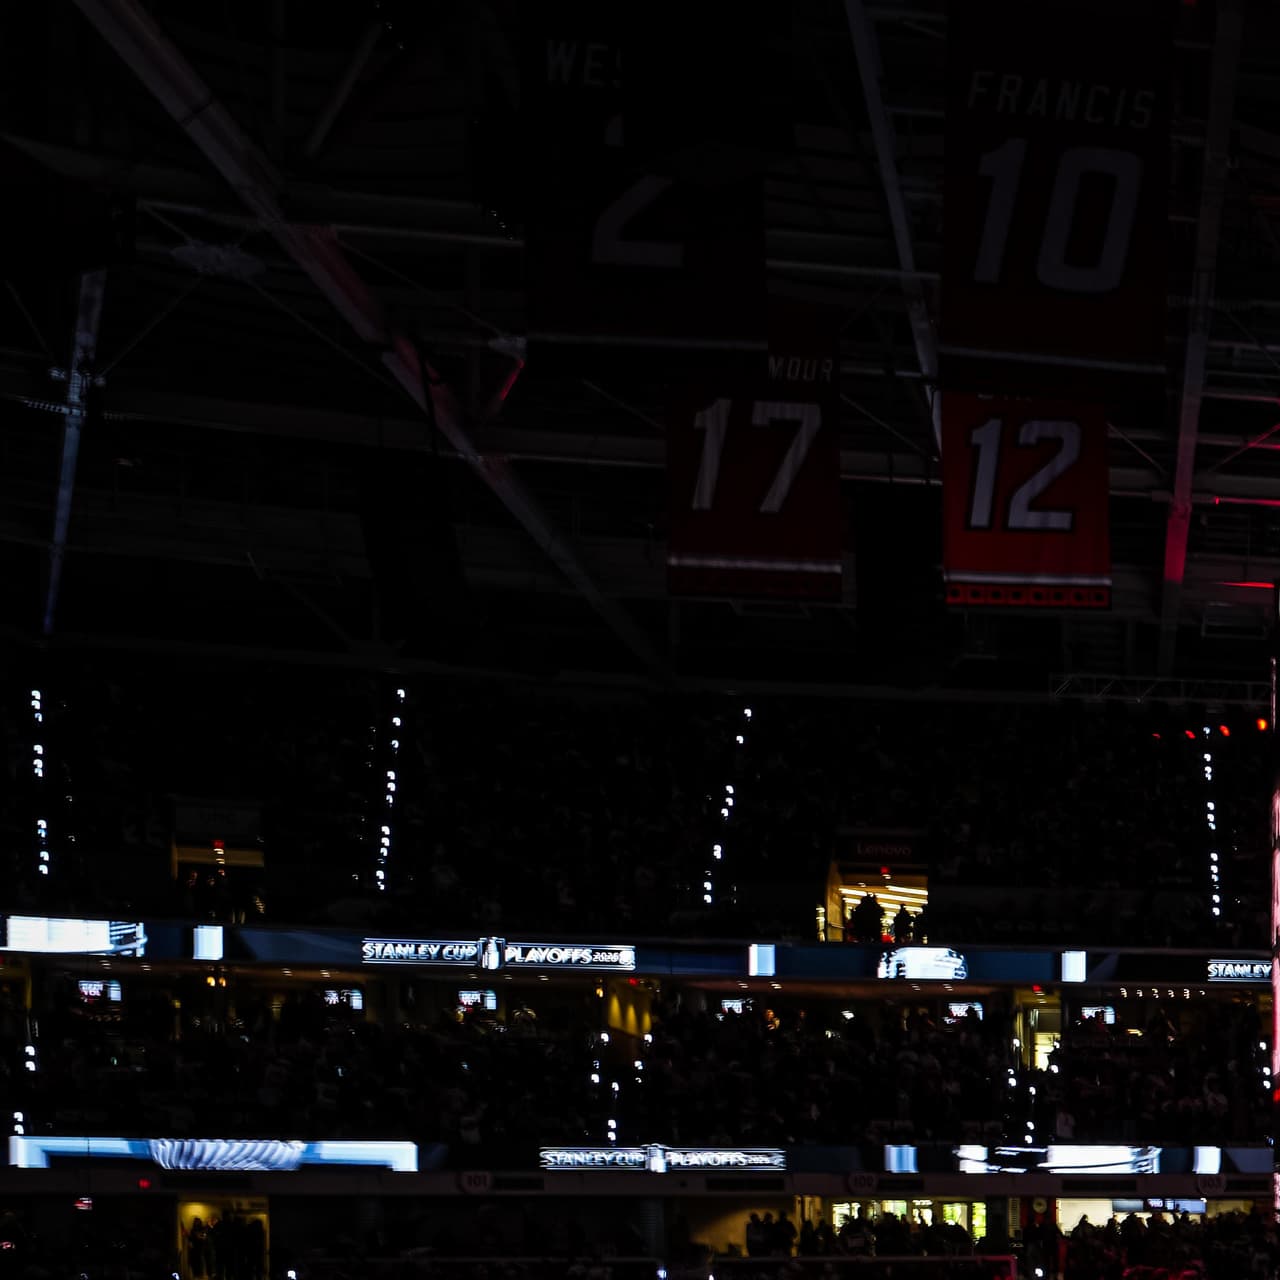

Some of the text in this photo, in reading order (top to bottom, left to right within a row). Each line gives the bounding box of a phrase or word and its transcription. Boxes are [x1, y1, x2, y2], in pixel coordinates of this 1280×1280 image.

[968, 70, 1156, 130] FRANCIS
[972, 136, 1145, 293] 10
[690, 396, 824, 515] 17
[967, 416, 1084, 531] 12
[361, 942, 441, 961] STANLEY
[442, 944, 478, 961] CUP
[505, 946, 592, 965] PLAYOFFS
[1207, 962, 1273, 978] STANLEY
[541, 1150, 612, 1166] STANLEY
[614, 1151, 646, 1166] CUP
[668, 1151, 749, 1167] PLAYOFFS
